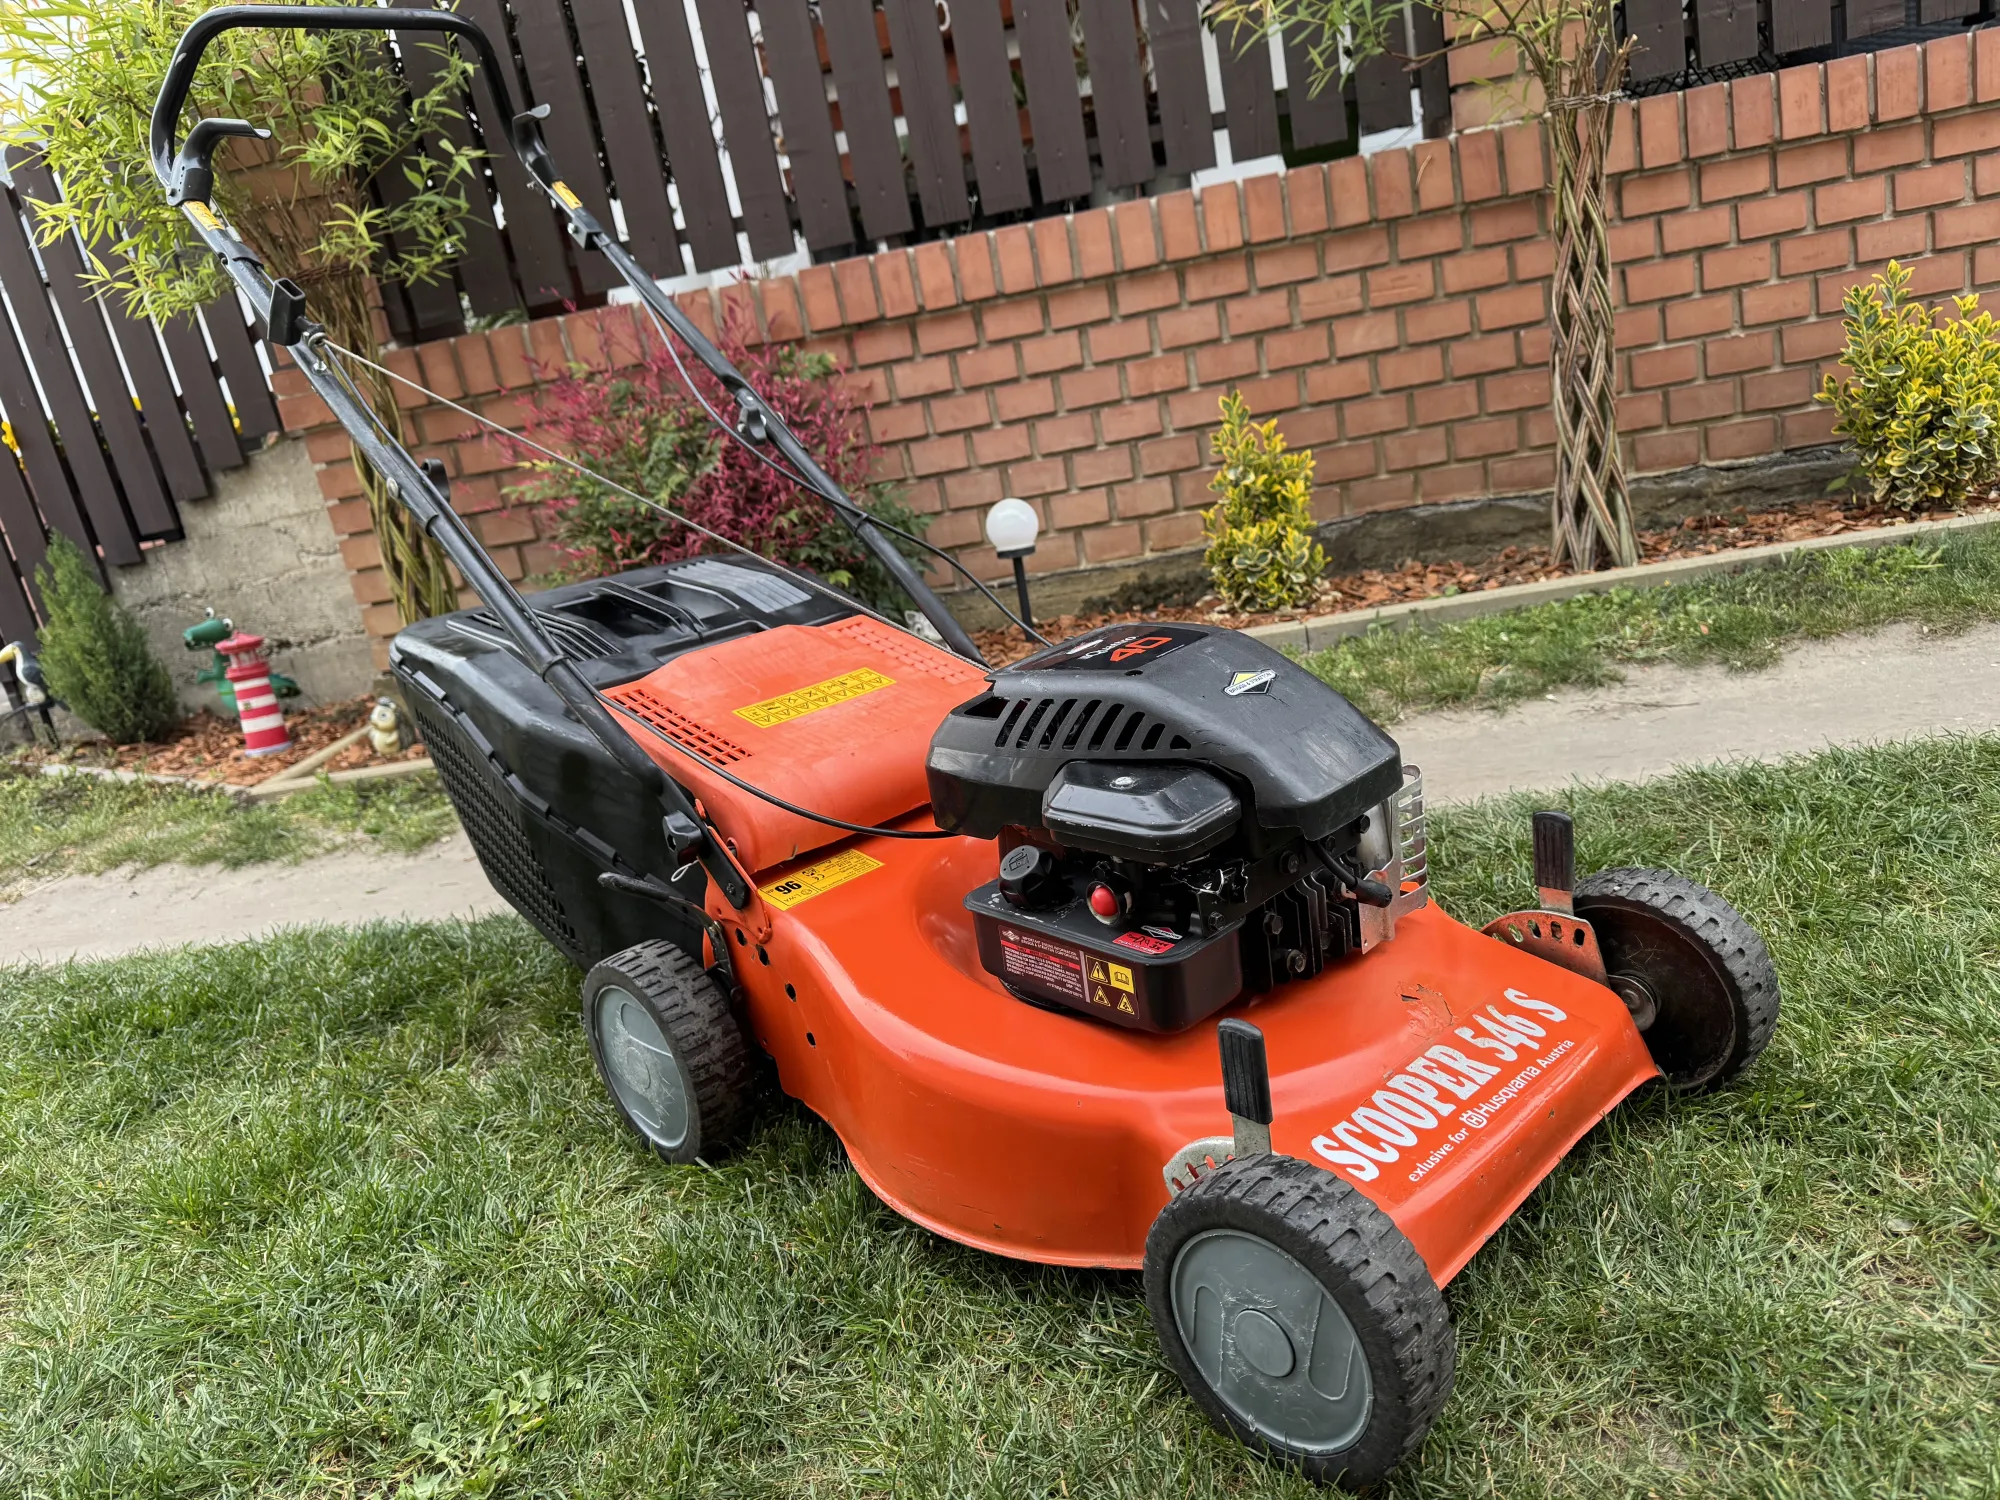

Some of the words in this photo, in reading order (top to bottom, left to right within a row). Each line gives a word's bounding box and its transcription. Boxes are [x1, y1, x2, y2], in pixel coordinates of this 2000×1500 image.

[1109, 636, 1173, 662] 40
[774, 880, 802, 895] 96
[1311, 1044, 1501, 1182] SCOOPER
[1454, 1004, 1547, 1062] 546
[1503, 987, 1568, 1023] S
[1408, 1142, 1454, 1183] exlusive
[1448, 1126, 1470, 1145] for
[1474, 1065, 1541, 1118] Husqvarna
[1536, 1038, 1575, 1069] Austria
